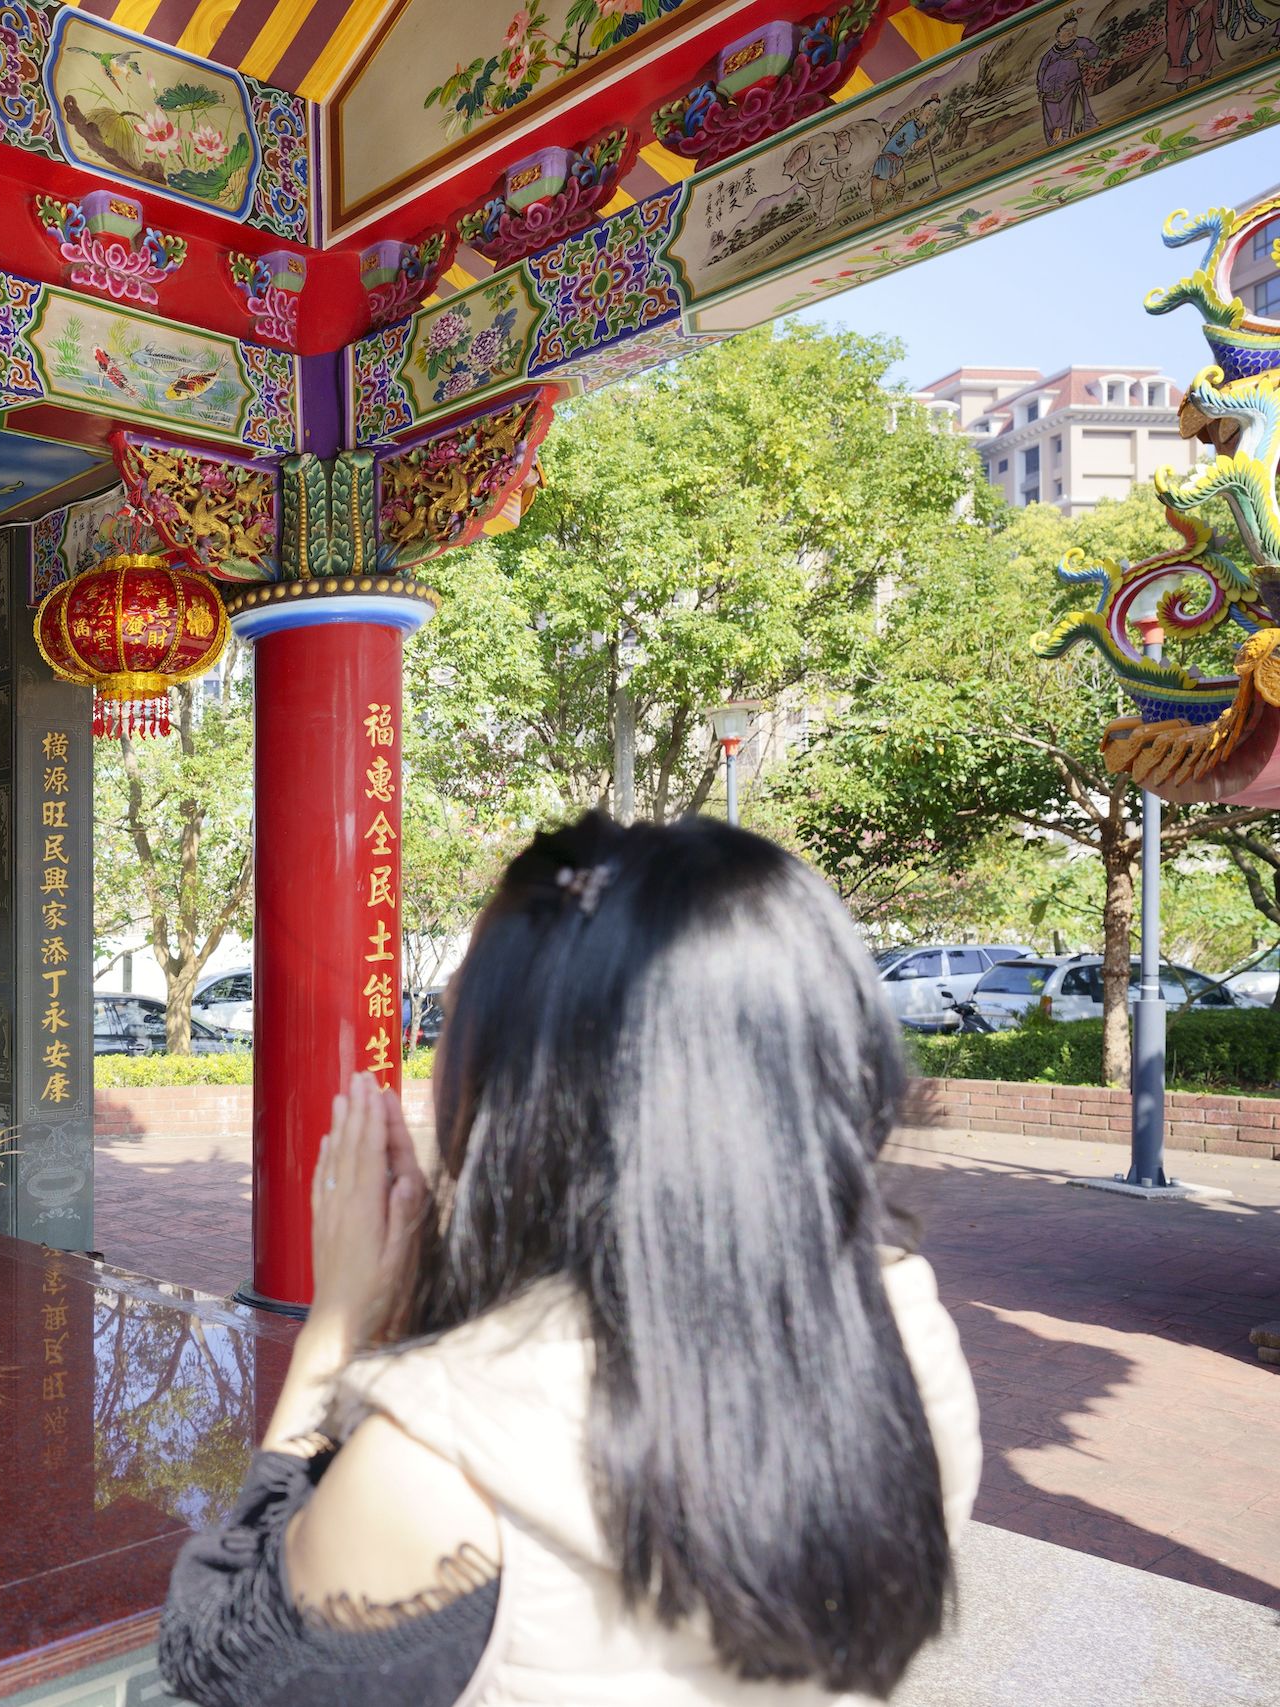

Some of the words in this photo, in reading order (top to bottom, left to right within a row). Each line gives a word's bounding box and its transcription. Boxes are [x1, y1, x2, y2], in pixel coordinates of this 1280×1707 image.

[40, 731, 70, 1104] 橫源旺民興家添丁永安康
[363, 702, 397, 1095] 福惠全民土能生
